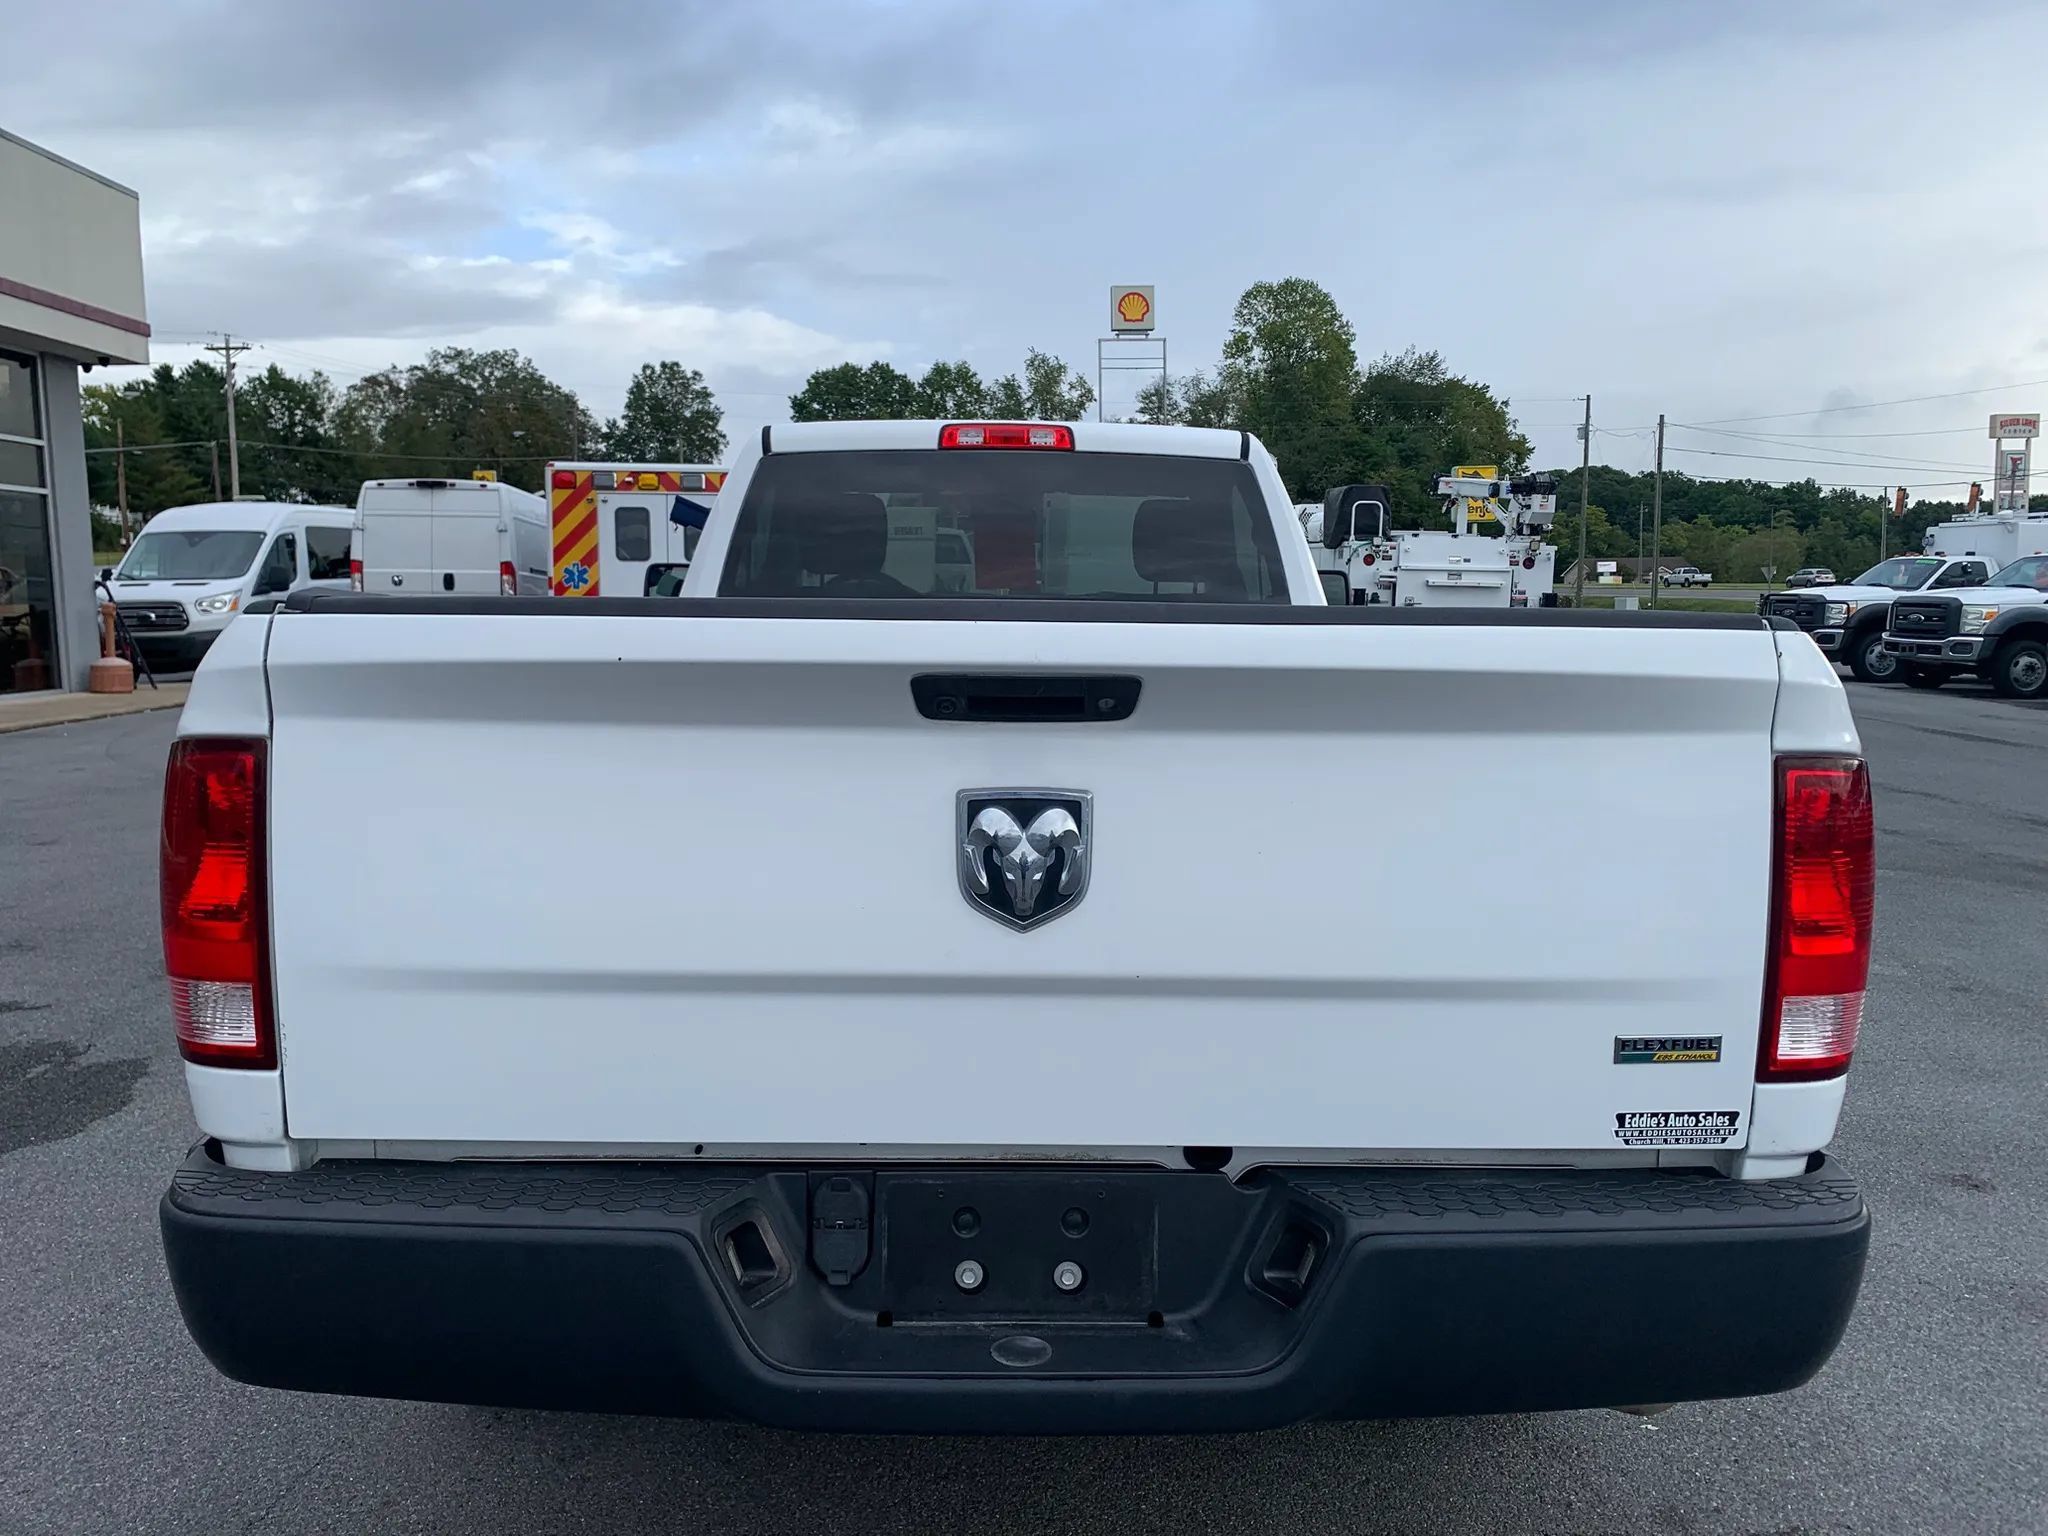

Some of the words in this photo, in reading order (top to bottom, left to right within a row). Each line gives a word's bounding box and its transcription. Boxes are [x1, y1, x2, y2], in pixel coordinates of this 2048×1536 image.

[1620, 1038, 1719, 1052] FLEXFUEL
[1624, 1113, 1666, 1128] Eddie's
[1667, 1113, 1696, 1127] Auto
[1697, 1112, 1730, 1127] Sales
[1618, 1129, 1734, 1137] WWW.EDDIESAUTOSALES.NET
